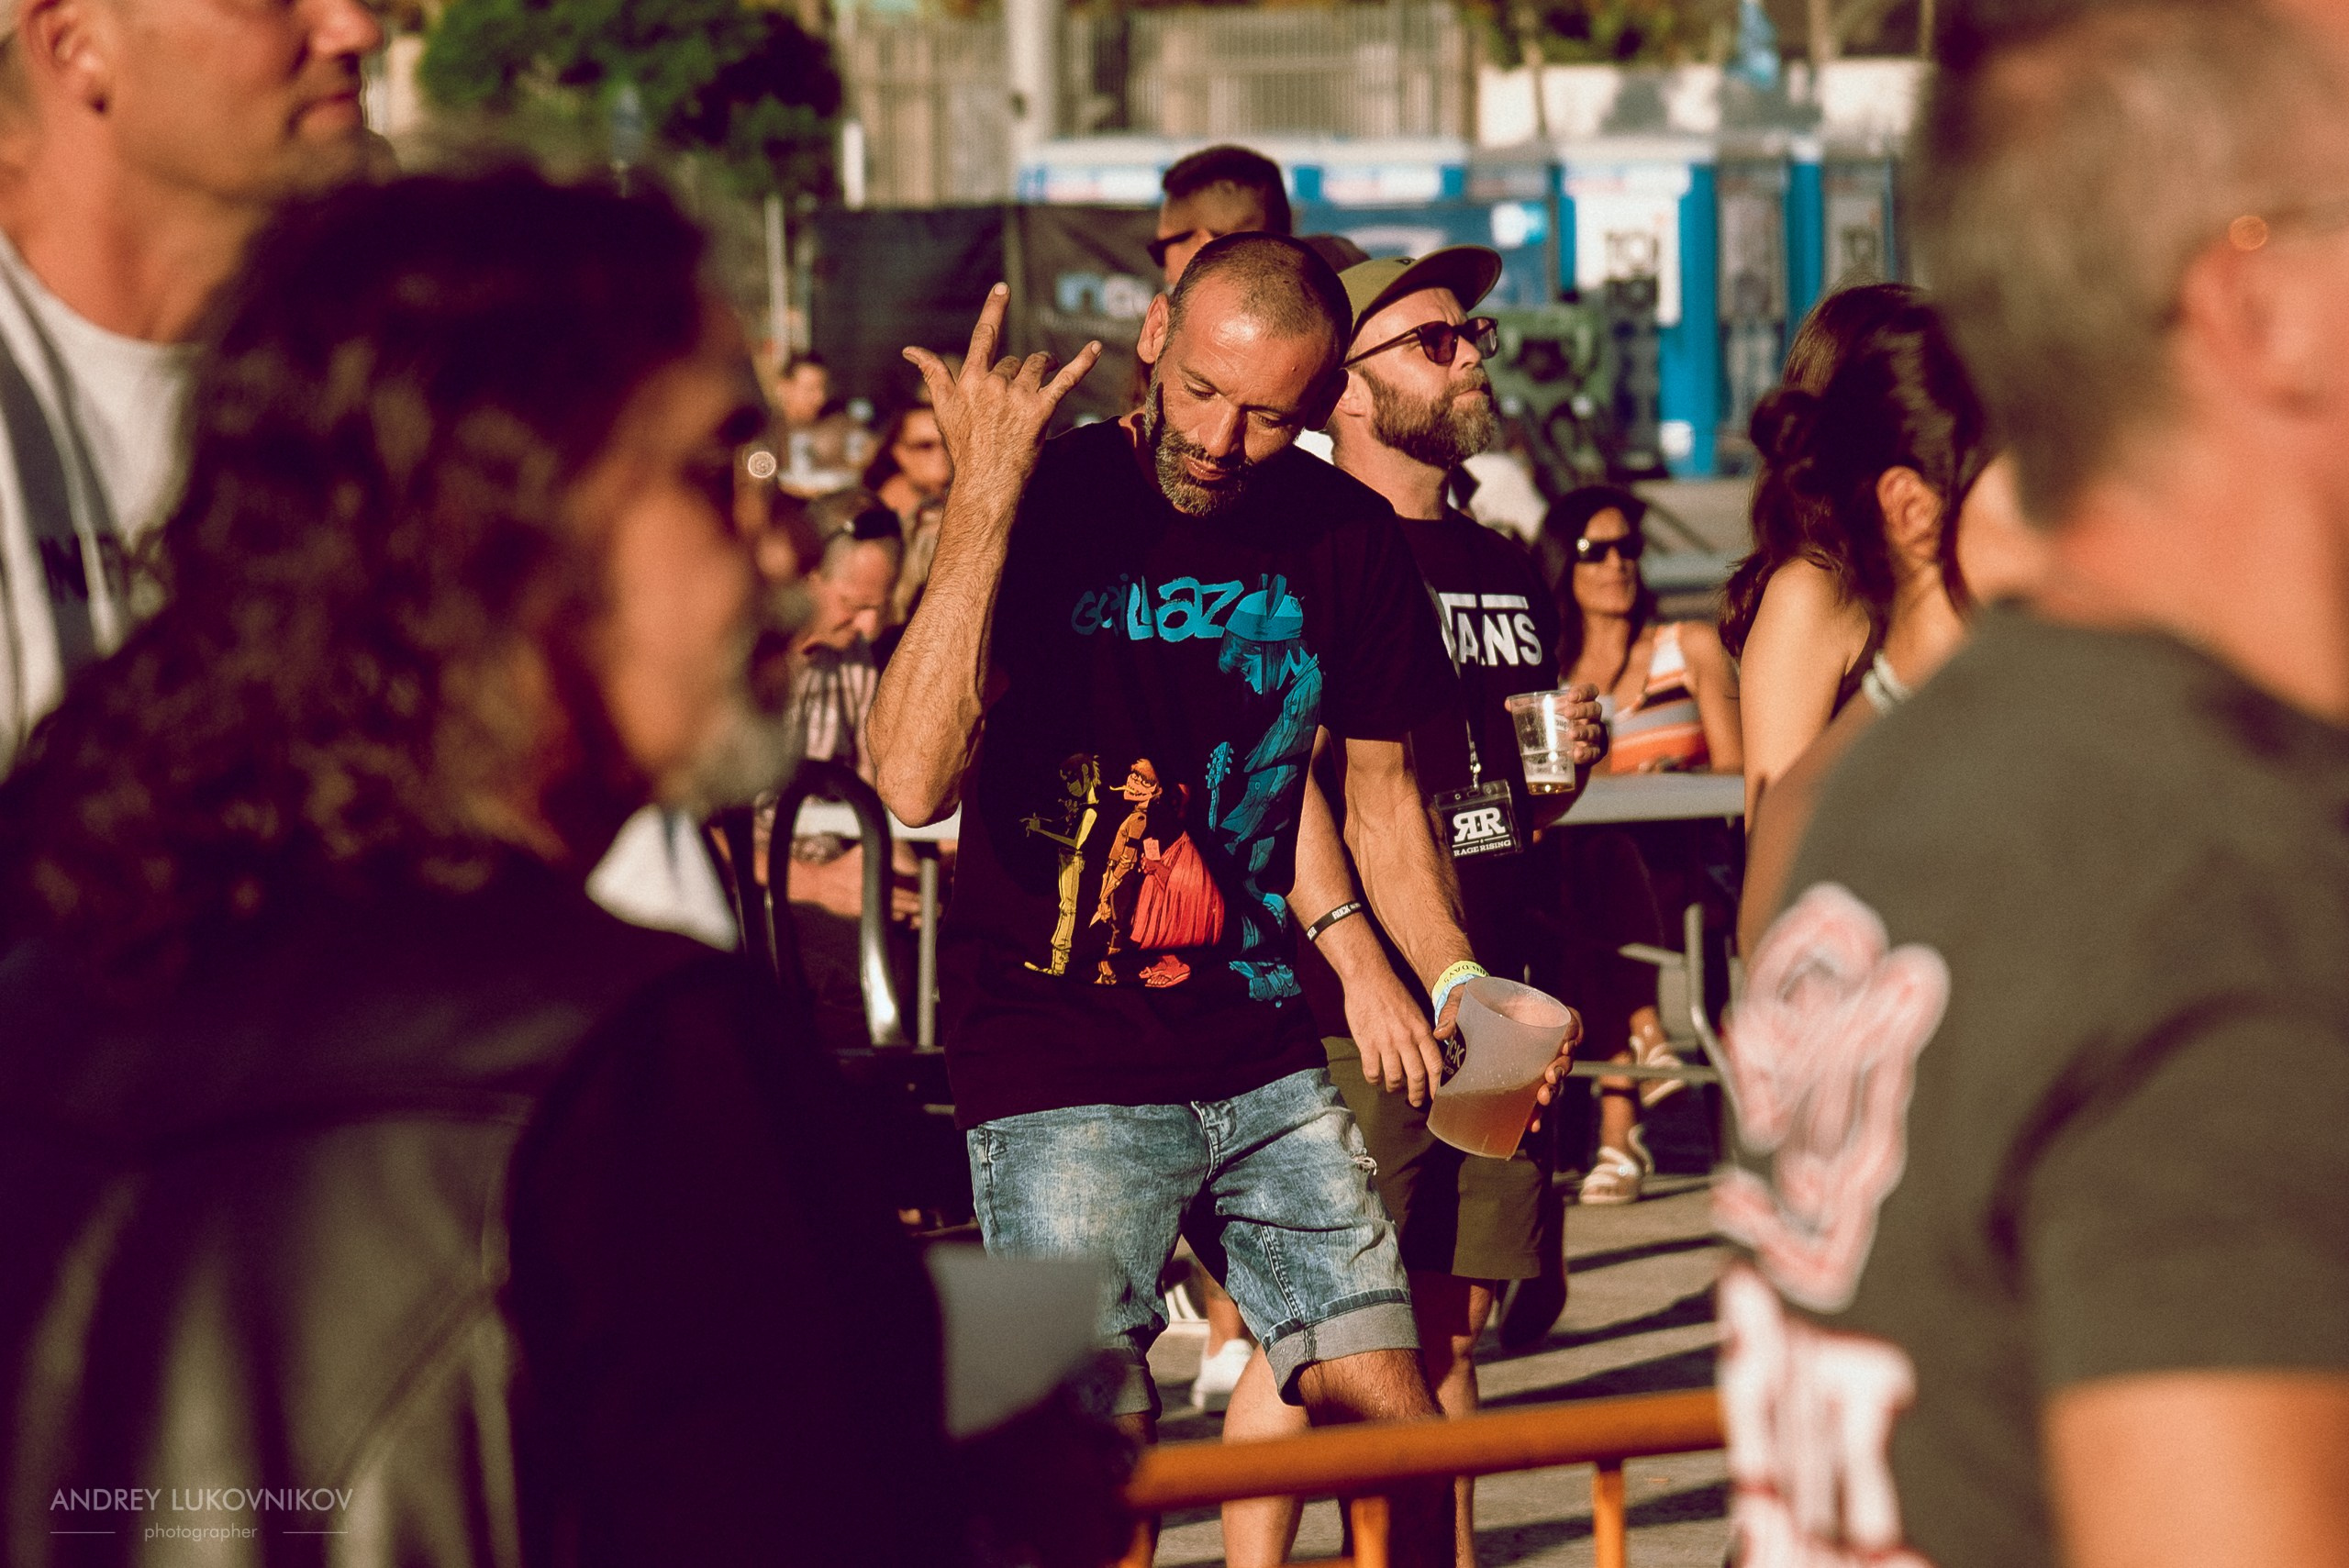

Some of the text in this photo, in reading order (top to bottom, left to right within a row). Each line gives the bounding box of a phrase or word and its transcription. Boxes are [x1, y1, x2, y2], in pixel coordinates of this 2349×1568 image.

[1438, 592, 1542, 666] VANS
[1453, 840, 1512, 857] RAGE RISING
[1331, 904, 1352, 920] ROCK
